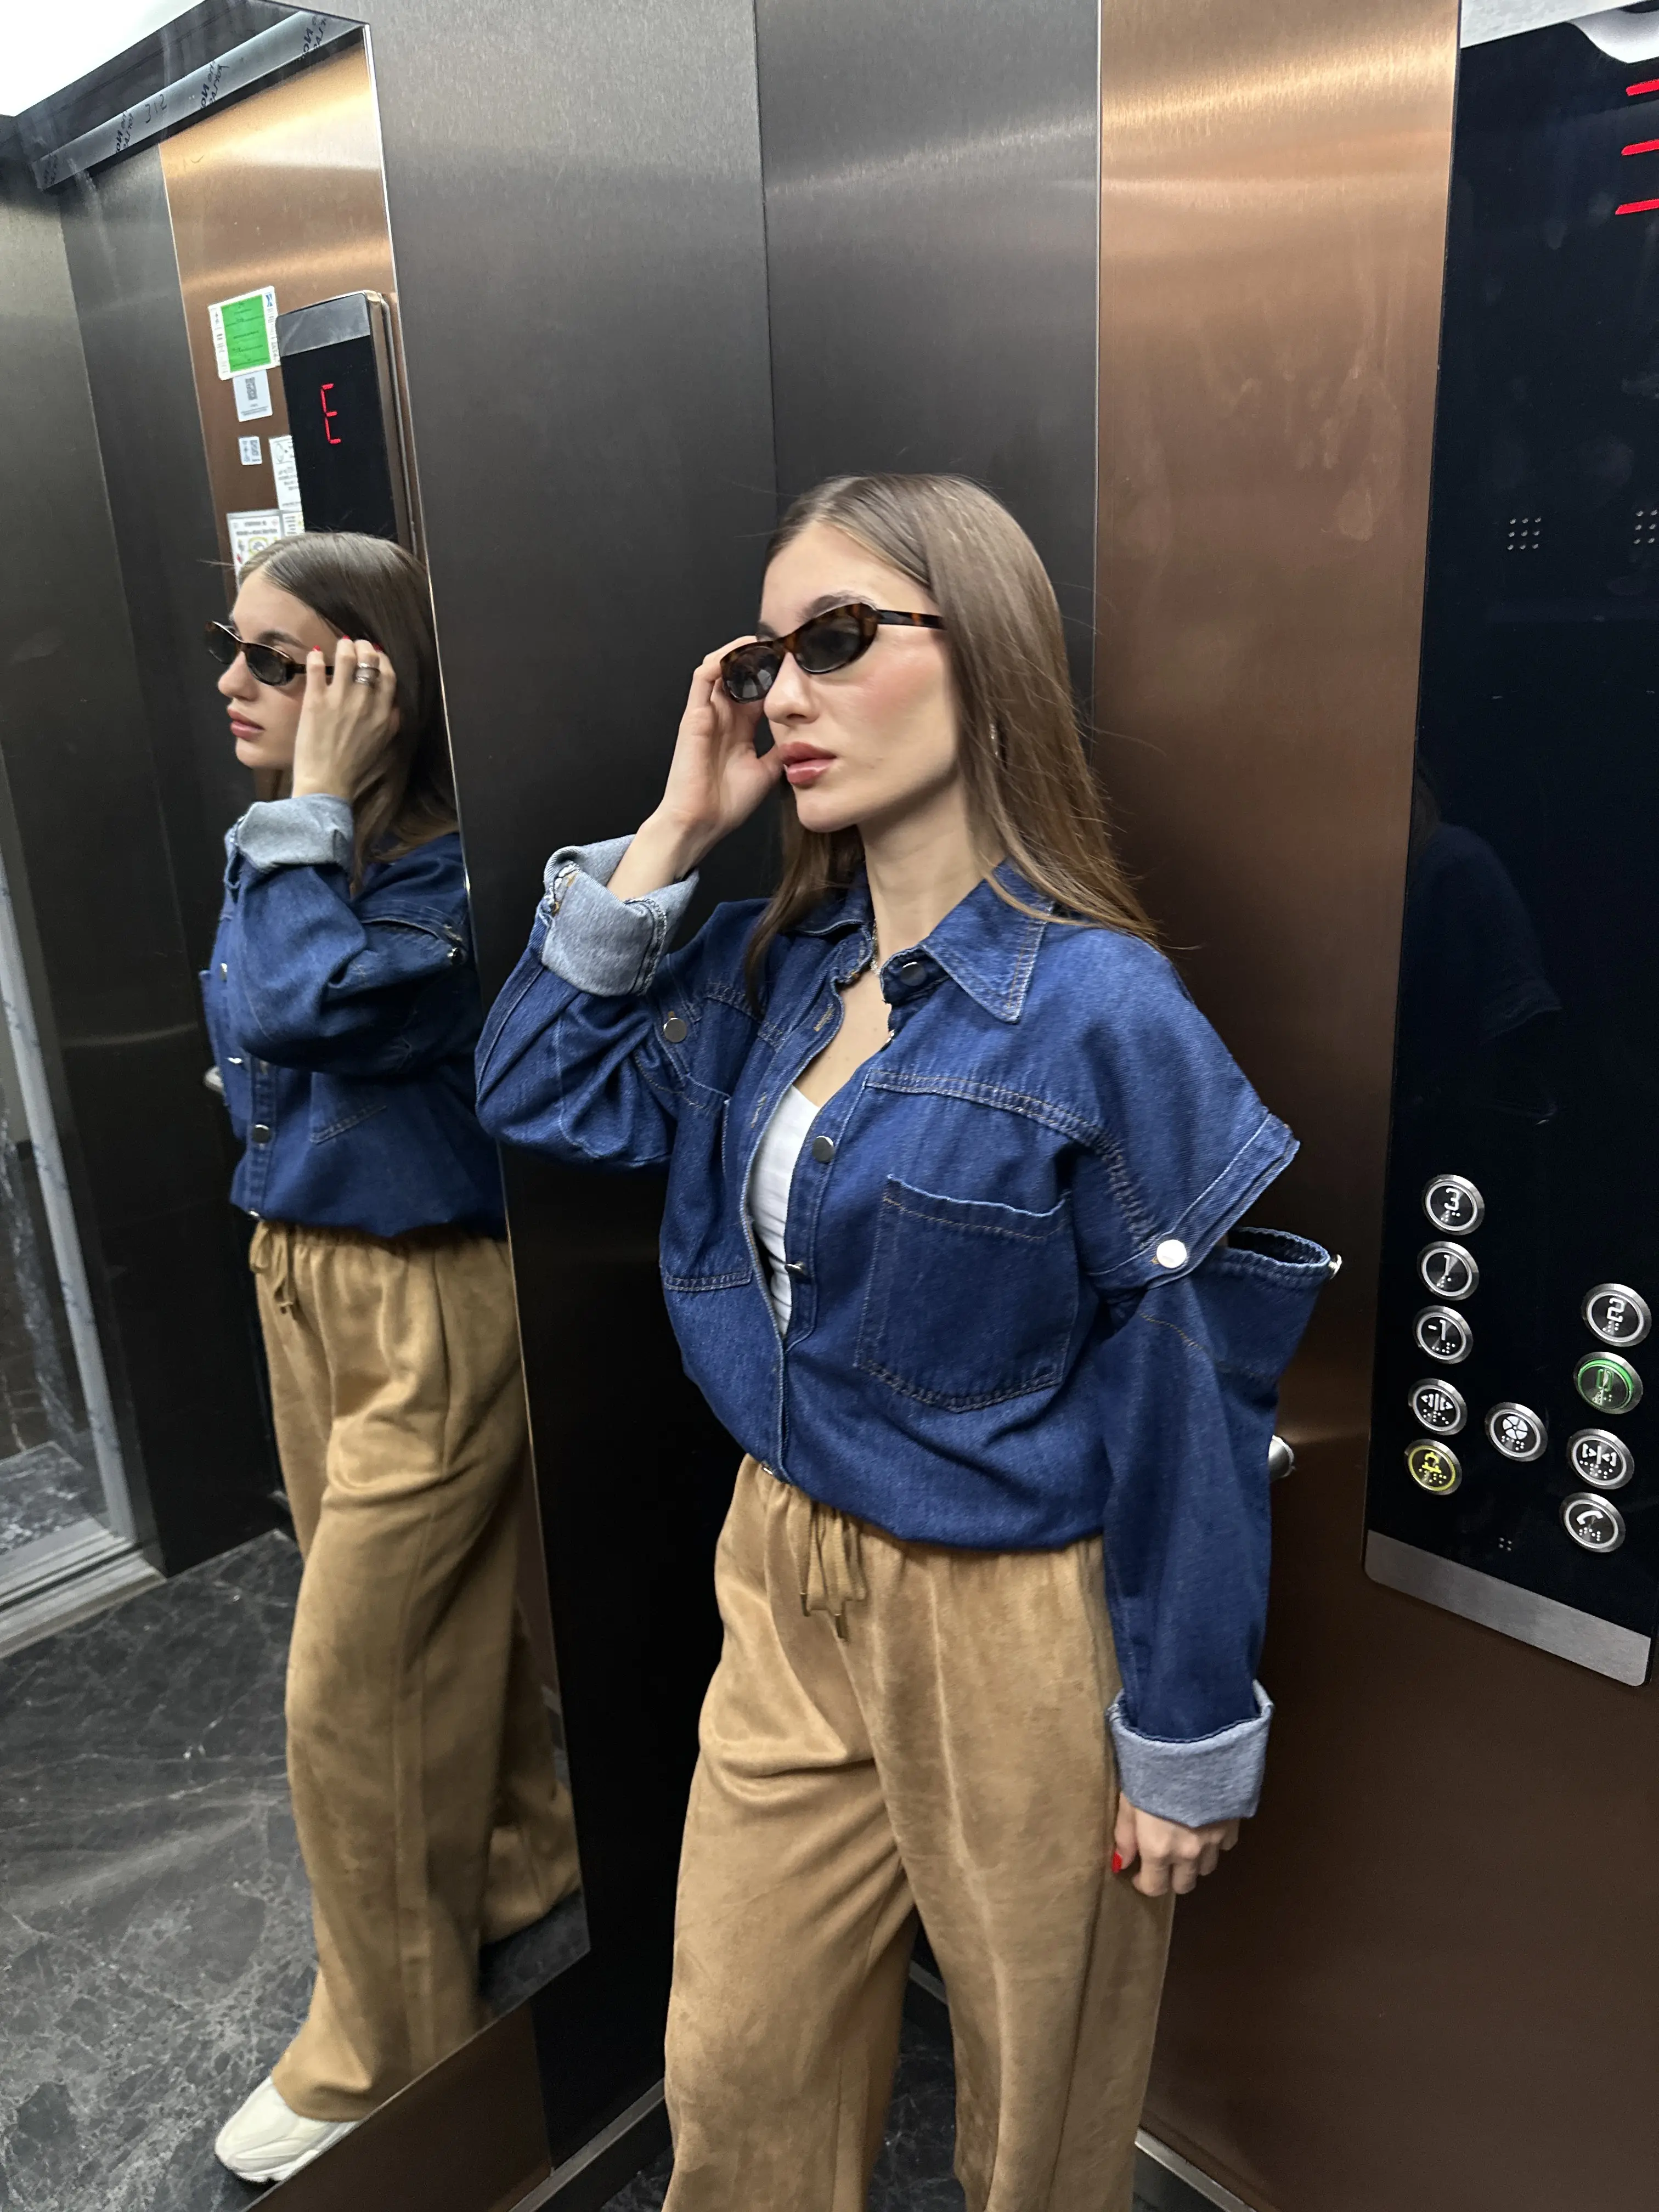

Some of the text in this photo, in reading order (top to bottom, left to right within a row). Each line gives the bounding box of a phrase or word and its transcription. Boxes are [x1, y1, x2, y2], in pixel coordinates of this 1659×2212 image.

[1444, 1187, 1461, 1211] 3
[1443, 1254, 1451, 1276] 1
[1606, 1296, 1626, 1323] 2
[1428, 1319, 1447, 1341] -1
[1596, 1368, 1614, 1392] 0
